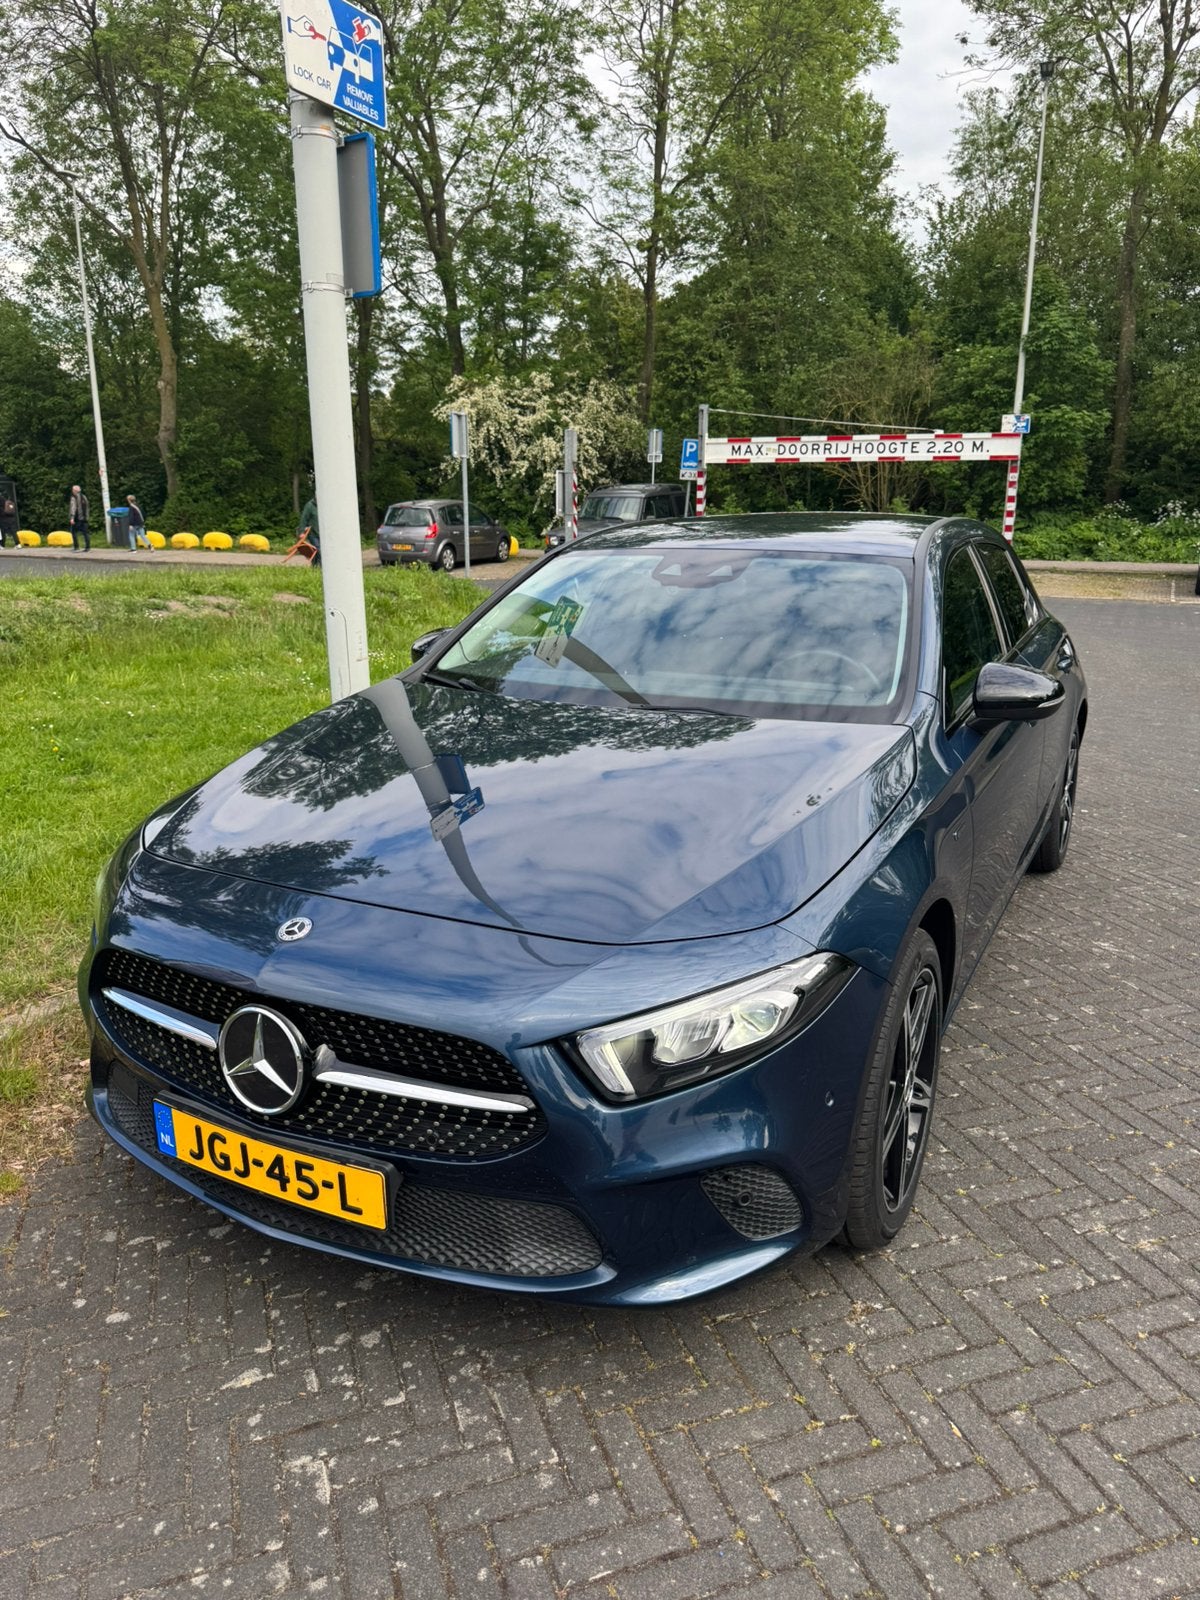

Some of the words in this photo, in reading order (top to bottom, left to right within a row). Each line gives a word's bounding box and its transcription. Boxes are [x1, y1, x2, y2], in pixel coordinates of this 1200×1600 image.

[293, 64, 314, 82] LOCK
[317, 76, 332, 91] CAR
[346, 83, 374, 104] REMOVE
[343, 95, 379, 120] VALUABLES
[686, 442, 697, 457] P
[731, 444, 769, 456] MAX.
[777, 441, 920, 455] DOORRIJHOOGTE
[926, 441, 964, 454] 2.20
[971, 440, 990, 453] M.
[160, 1132, 175, 1148] NL
[189, 1124, 363, 1216] JGJ-45-L
